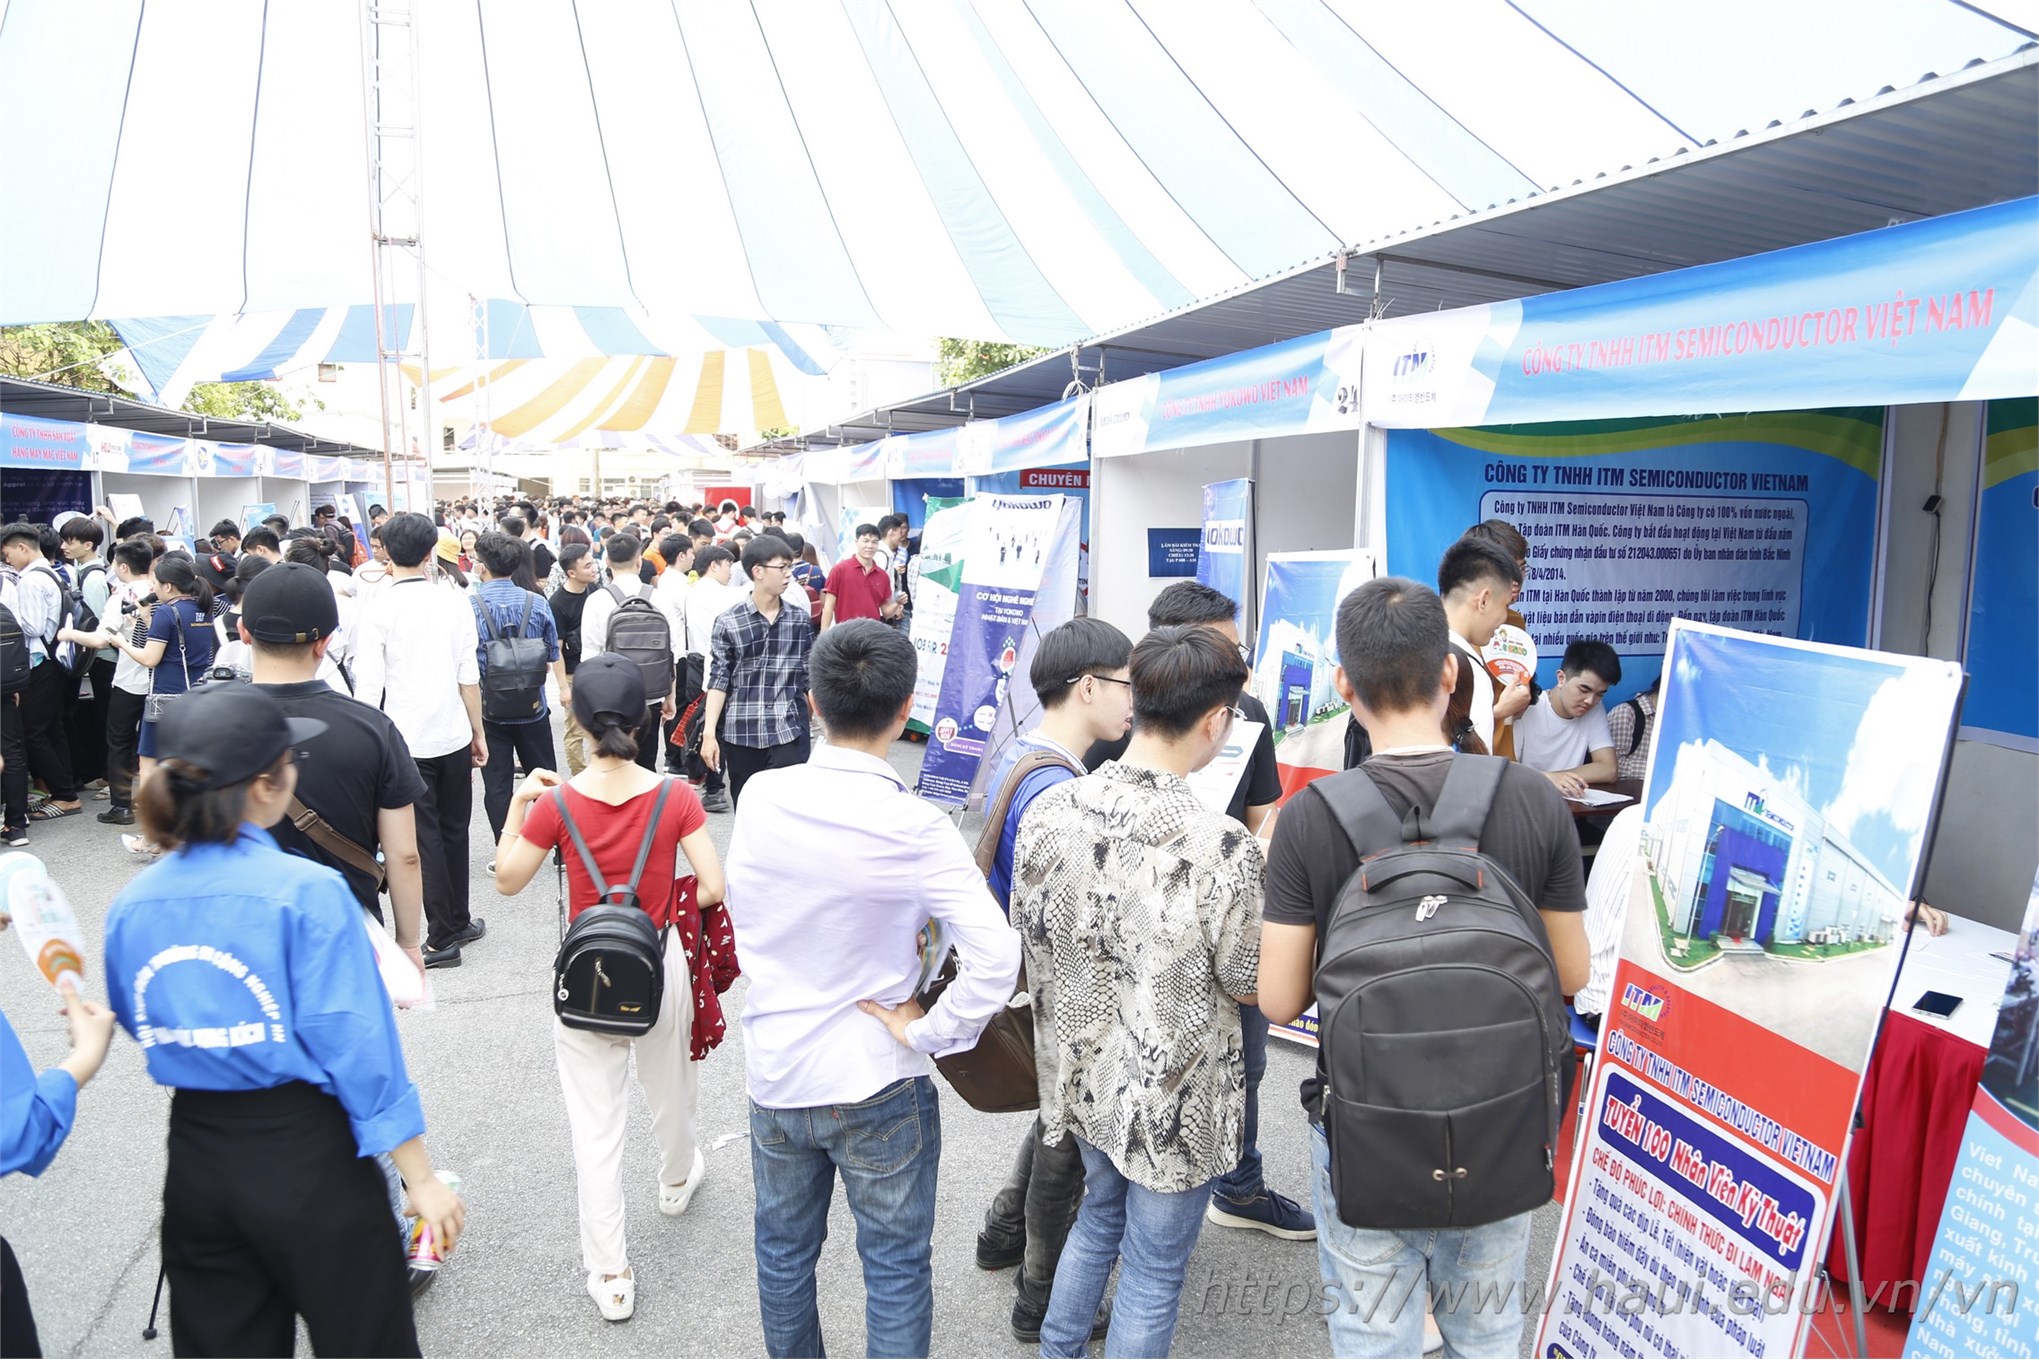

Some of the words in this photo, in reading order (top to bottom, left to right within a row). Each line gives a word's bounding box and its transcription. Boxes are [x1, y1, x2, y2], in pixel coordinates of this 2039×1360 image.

[1522, 339, 1562, 376] CÔNG
[1567, 342, 1585, 371] TY
[1588, 337, 1635, 368] TNHH
[1637, 332, 1671, 364] ITM
[1675, 306, 1859, 361] SEMICONDUCTOR
[1866, 289, 1921, 348] VIỆT
[1926, 287, 1995, 334] NAM
[1196, 396, 1217, 414] TNHH
[1219, 388, 1258, 409] YOKOWO
[1261, 380, 1281, 404] VIỆT
[1283, 376, 1309, 396] NAM
[66, 450, 78, 461] NAM
[1029, 472, 1081, 486] CHUYÊN
[1484, 460, 1527, 483] CÔNG
[1532, 465, 1549, 484] TY
[1554, 466, 1592, 486] TNHH
[1597, 467, 1624, 487] ITM
[1629, 468, 1747, 490] SEMICONDUCTOR
[1751, 473, 1809, 492] VIETNAM
[1494, 500, 1515, 515] Công
[1517, 502, 1525, 516] ty
[1527, 501, 1548, 514] TNHH
[1550, 502, 1564, 514] ITM
[1567, 502, 1629, 516] Semiconductor
[1630, 502, 1646, 519] Việt
[1647, 504, 1665, 517] Nam
[1667, 504, 1674, 517] là
[1676, 504, 1695, 519] Công
[1697, 505, 1704, 519] ty
[1706, 505, 1715, 518] có
[1717, 505, 1737, 519] 100%
[1739, 504, 1752, 519] vốn
[1534, 523, 1553, 537] đoàn
[1555, 523, 1570, 536] ITM
[1571, 523, 1587, 537] Hàn
[1589, 521, 1611, 538] Quốc.
[1613, 525, 1633, 539] Công
[1634, 526, 1642, 539] ty
[1711, 527, 1721, 542] tại
[1723, 526, 1737, 542] Việt
[1738, 527, 1754, 540] Nam
[1533, 544, 1548, 559] Giấy
[1575, 547, 1592, 562] nhận
[1526, 591, 1540, 602] ITM
[1555, 589, 1569, 602] Hàn
[1571, 587, 1590, 602] Quốc
[1592, 589, 1613, 602] thành
[1614, 590, 1626, 605] lập
[1637, 589, 1653, 602] năm
[1655, 590, 1675, 603] 2000,
[1537, 611, 1551, 626] liệu
[1621, 982, 1664, 1022] ITM
[1608, 1029, 1634, 1064] CÔNG
[1634, 1044, 1649, 1073] TY
[1647, 1052, 1672, 1088] TNHH
[1671, 1068, 1692, 1098] ITM
[1691, 1077, 1782, 1152] SEMICONDUCTOR
[1781, 1127, 1838, 1185] VIETNAM
[1604, 1095, 1645, 1145] TUYỂN
[1643, 1120, 1672, 1162] 100
[1670, 1139, 1709, 1189] Nhân
[1707, 1161, 1739, 1209] Viên
[1757, 1194, 1805, 1255] Thuật
[1962, 1166, 2027, 1208] chuyên
[2013, 1164, 2039, 1190] Na
[1592, 1147, 1611, 1172] CHẾ
[1609, 1159, 1623, 1184] ĐỘ
[1623, 1169, 1647, 1199] PHÚC
[1648, 1186, 1665, 1213] LỢI:
[1668, 1200, 1698, 1236] CHÍNH
[1699, 1222, 1725, 1254] THỨC
[1726, 1241, 1738, 1265] ĐI
[1739, 1251, 1763, 1282] LÀM
[1956, 1187, 2006, 1220] chính
[1951, 1205, 2007, 1249] Giang,
[1939, 1248, 1976, 1278] máy
[1944, 1227, 1983, 1257] xuất
[1987, 1249, 2028, 1282] kinh
[1917, 1326, 1955, 1359] Nam
